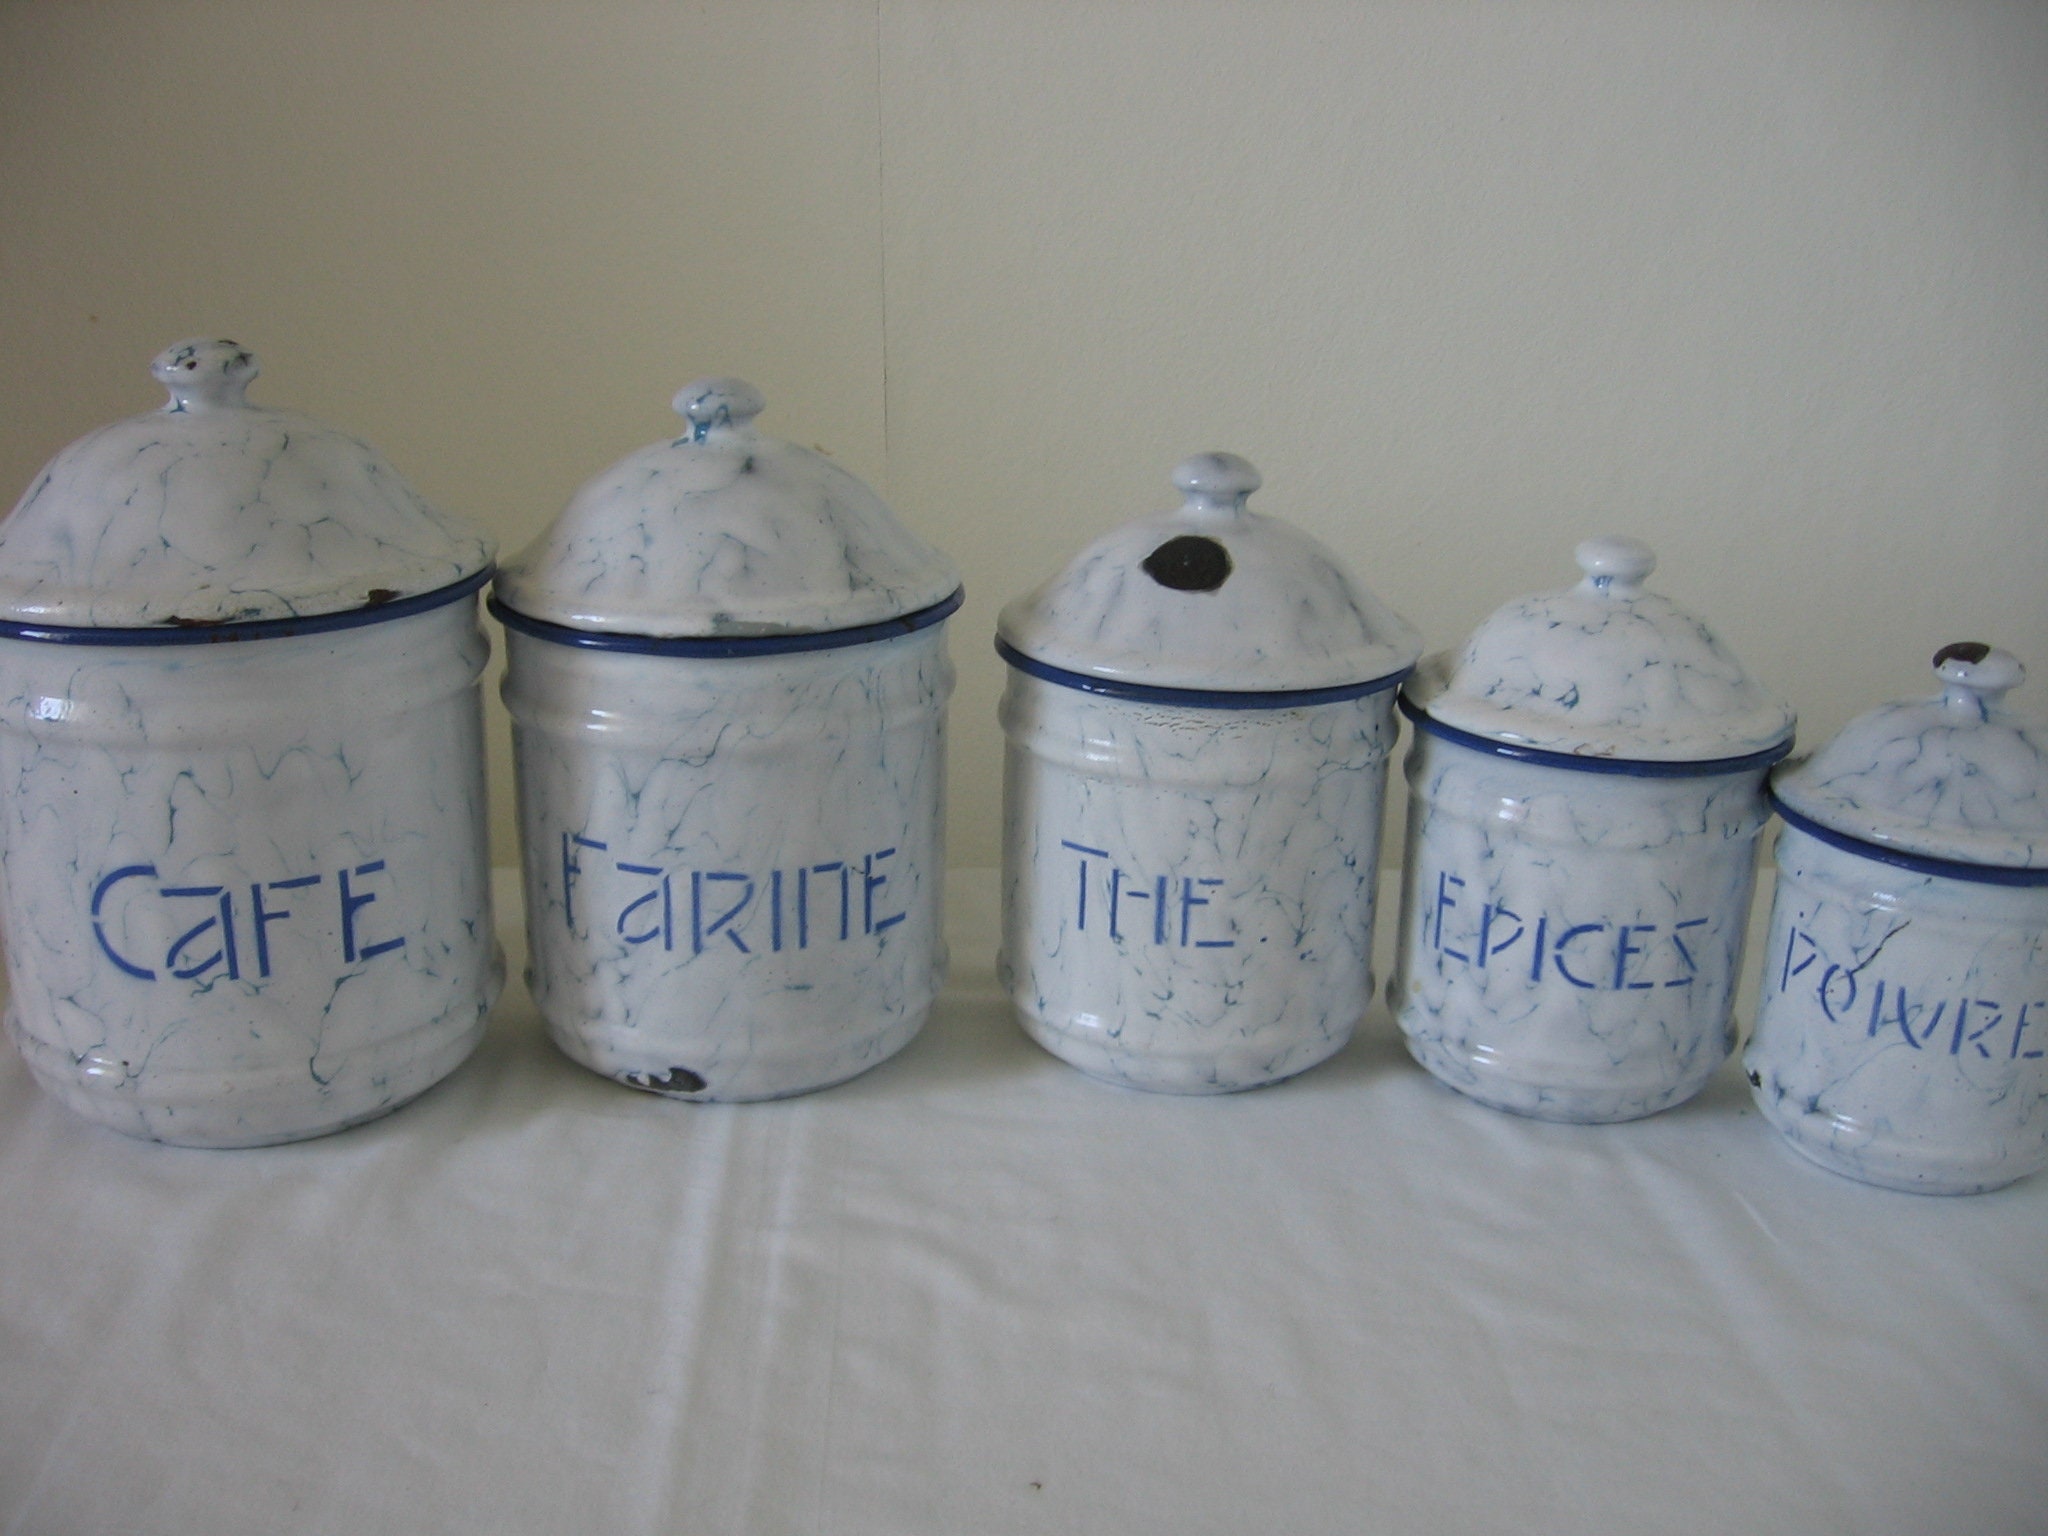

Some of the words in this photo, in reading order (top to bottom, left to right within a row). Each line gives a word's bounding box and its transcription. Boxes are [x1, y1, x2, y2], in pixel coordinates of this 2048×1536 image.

[1060, 838, 1236, 948] THE
[1433, 870, 1709, 990] EPICES
[1780, 925, 2046, 1060] POIVRE
